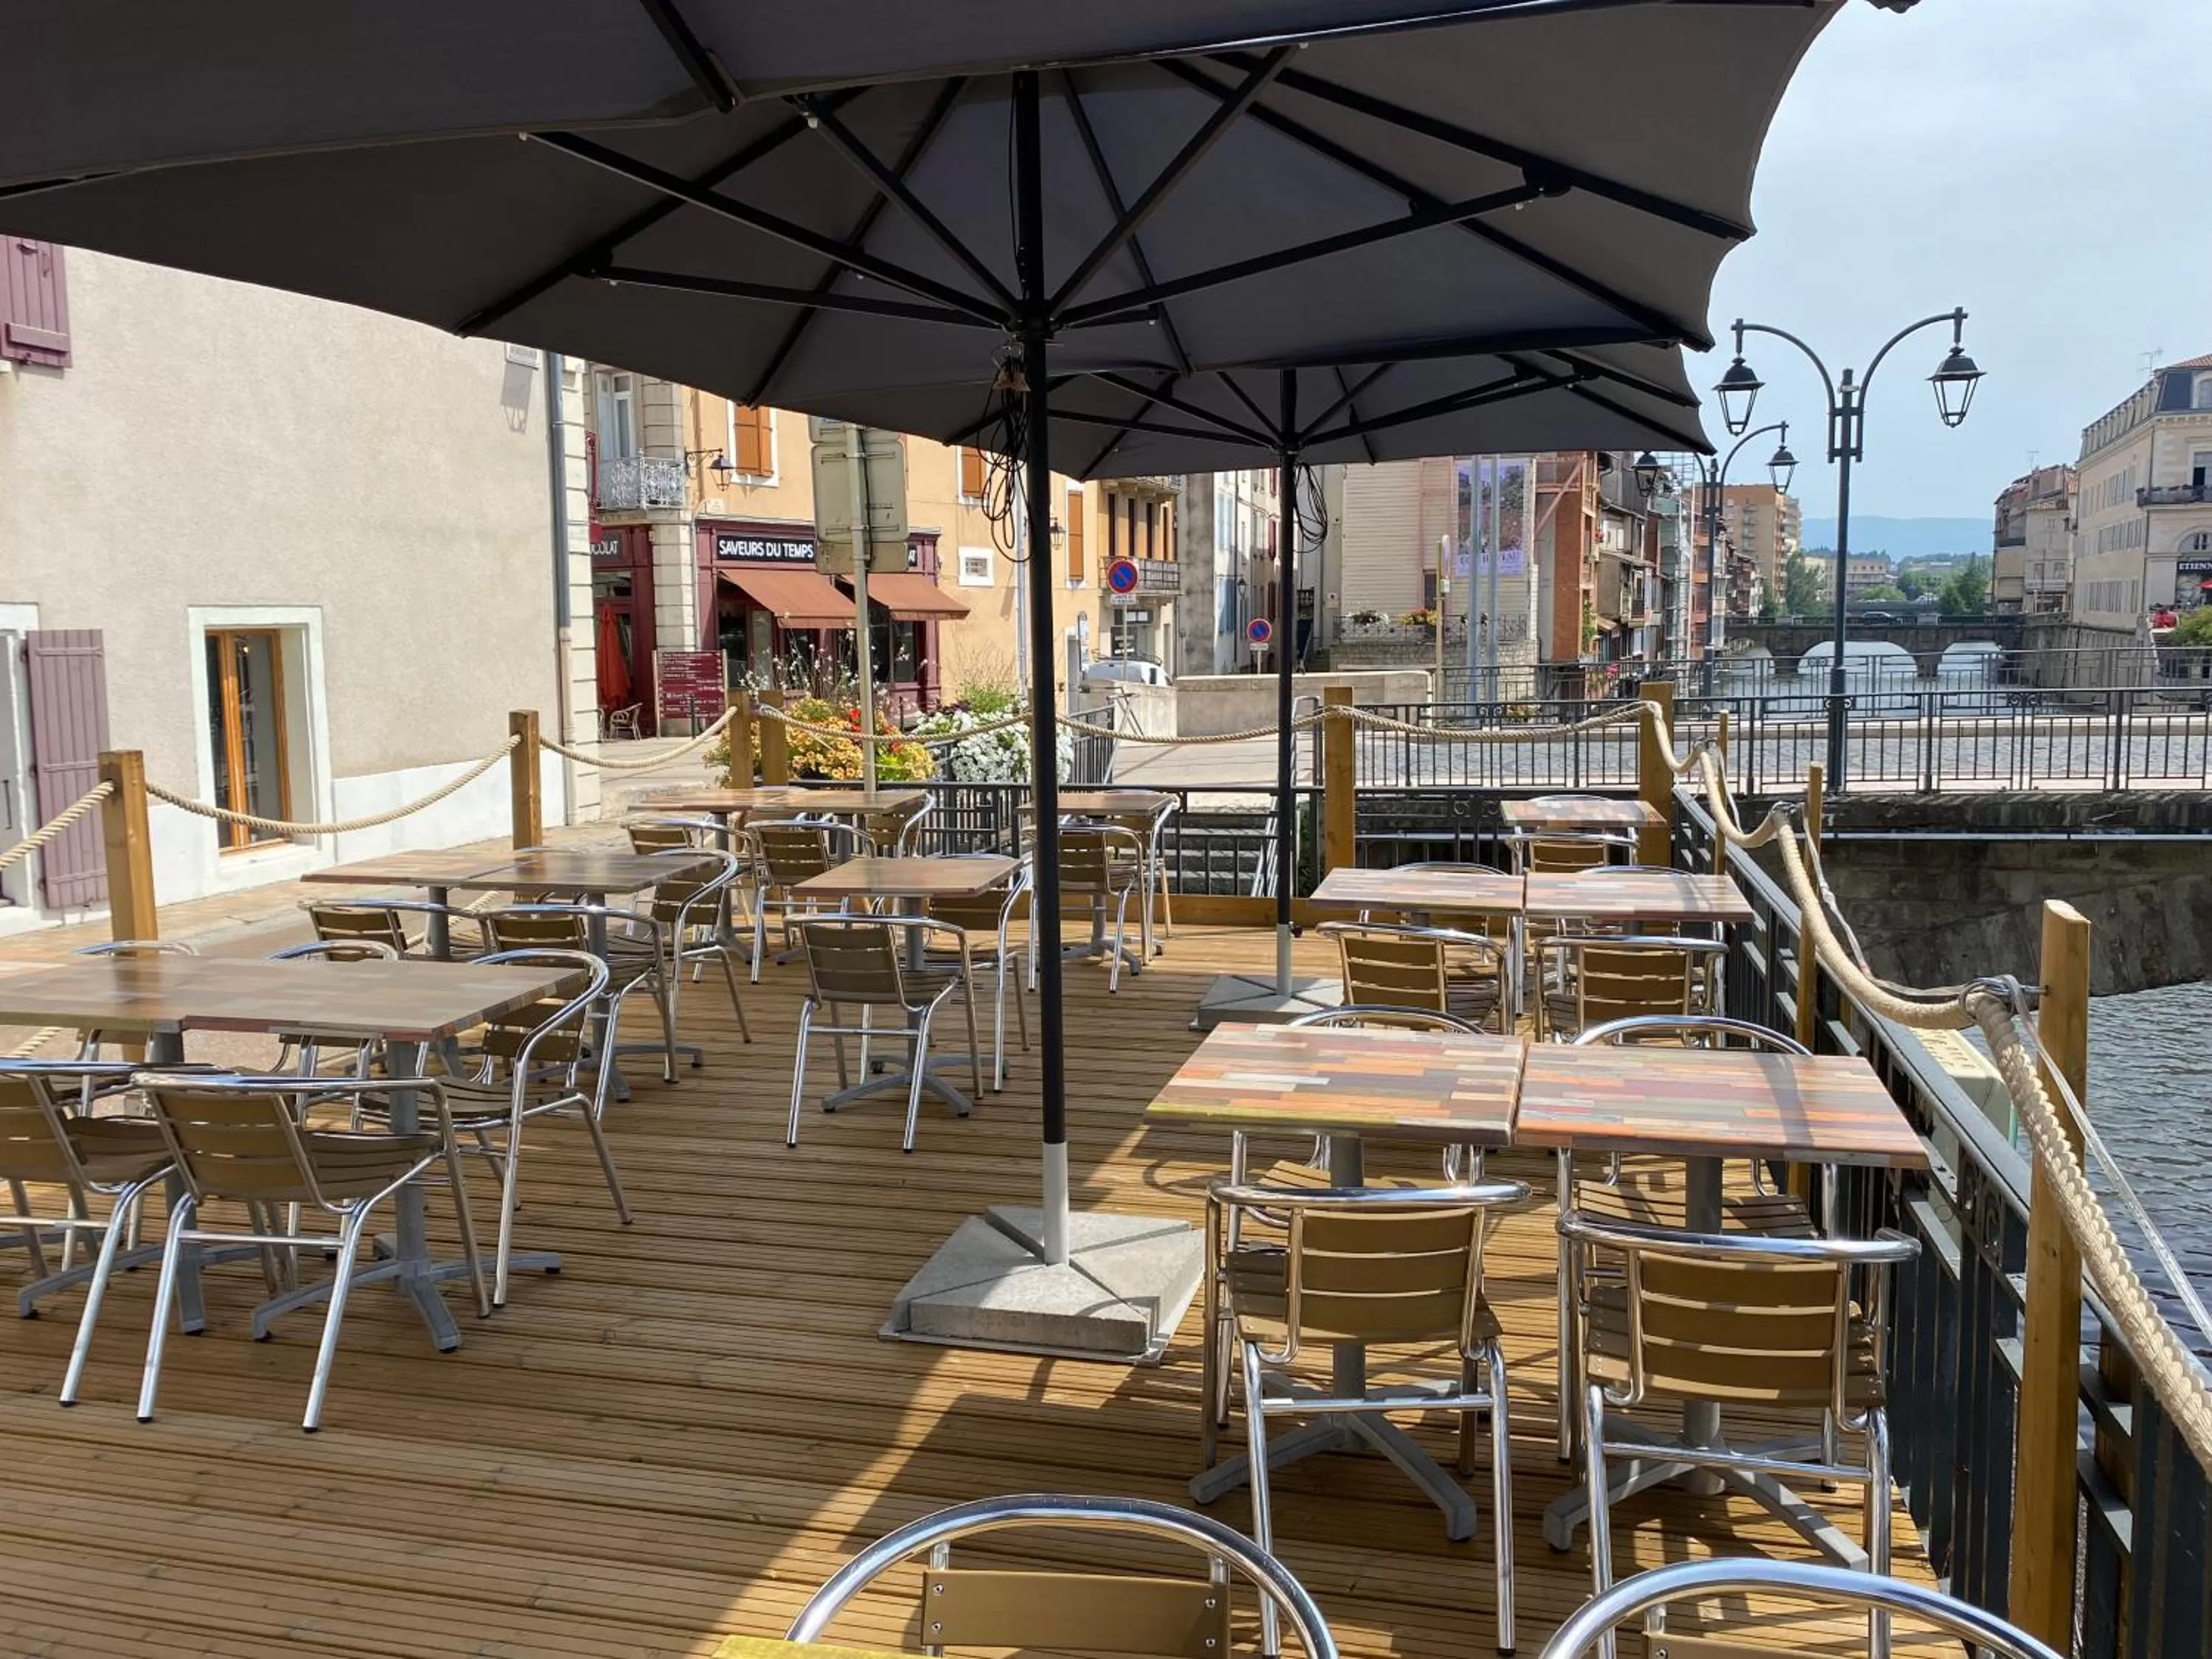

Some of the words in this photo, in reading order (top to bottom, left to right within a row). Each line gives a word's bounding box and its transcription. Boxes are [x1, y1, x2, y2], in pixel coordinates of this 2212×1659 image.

[719, 540, 765, 557] SAVEURS
[766, 542, 781, 557] DU
[782, 543, 814, 558] TEMPS
